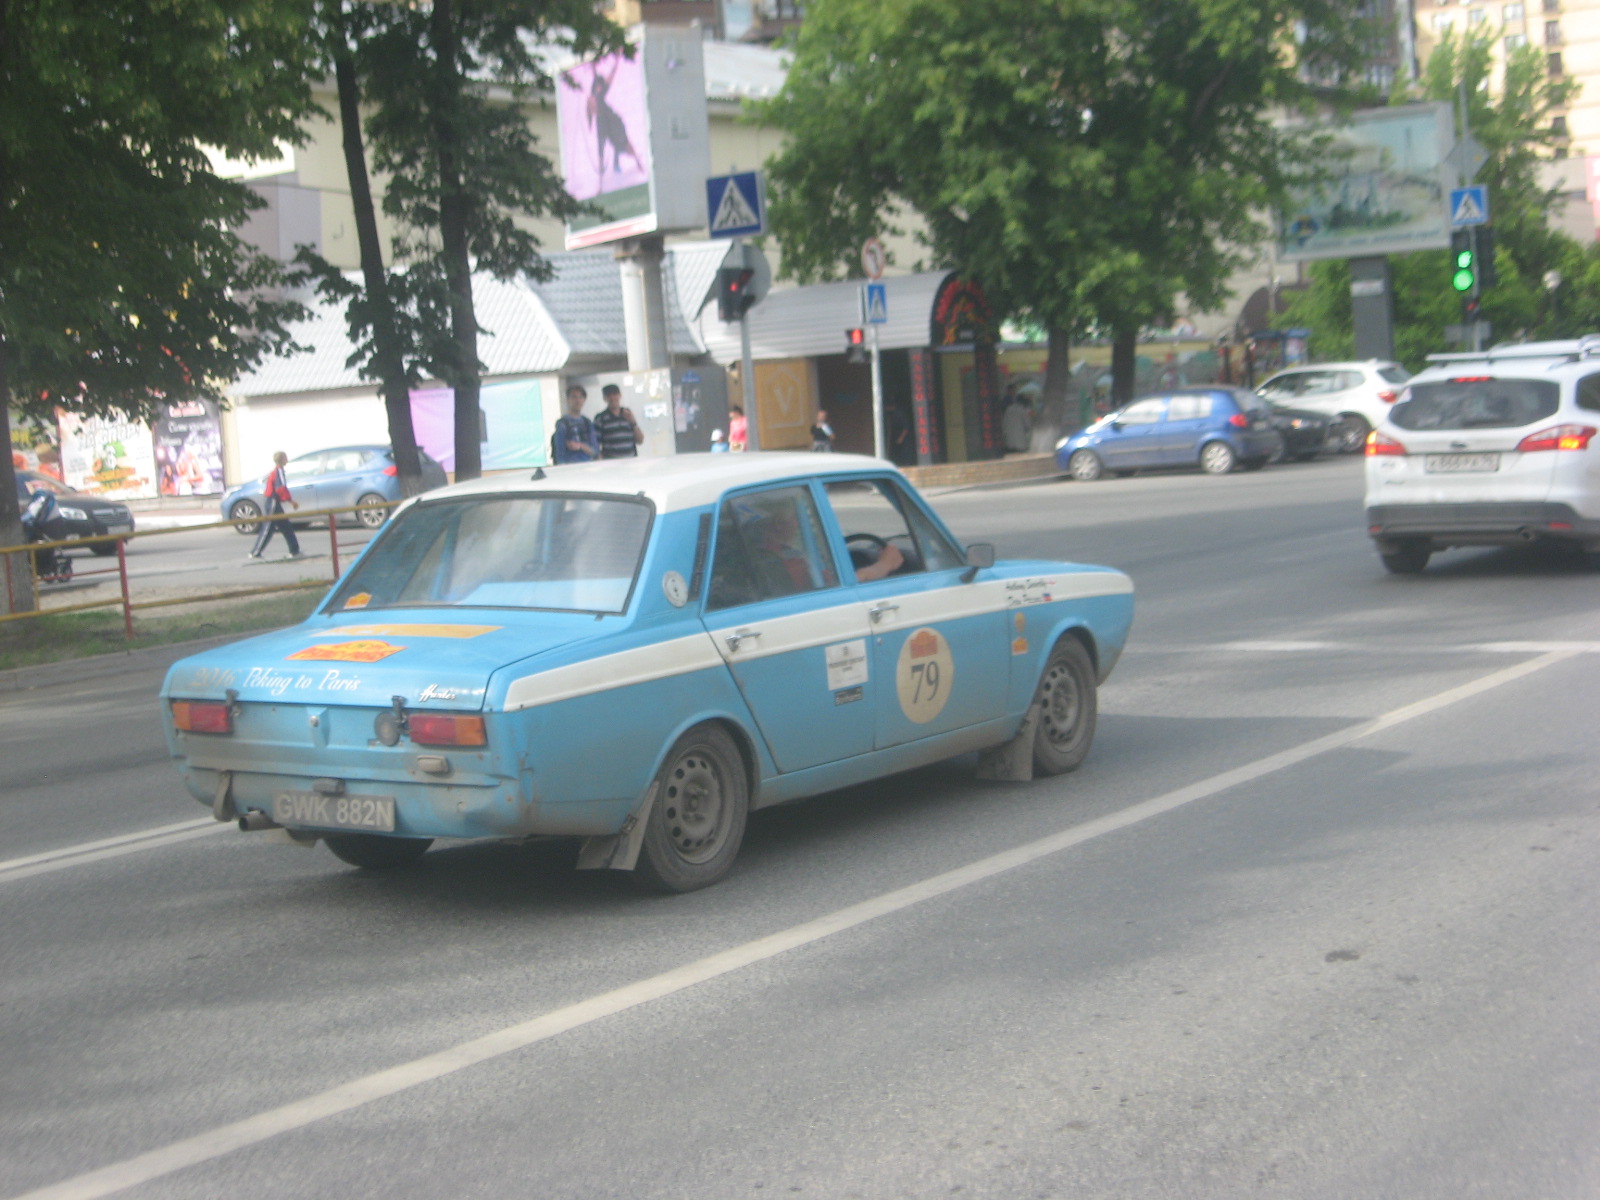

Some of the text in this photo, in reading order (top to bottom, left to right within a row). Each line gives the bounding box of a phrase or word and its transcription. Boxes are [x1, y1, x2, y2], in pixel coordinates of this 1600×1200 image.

[243, 667, 293, 696] Peking
[294, 675, 312, 689] to
[318, 669, 362, 691] Paris
[910, 661, 940, 704] 79
[277, 793, 393, 827] GWK 882N
